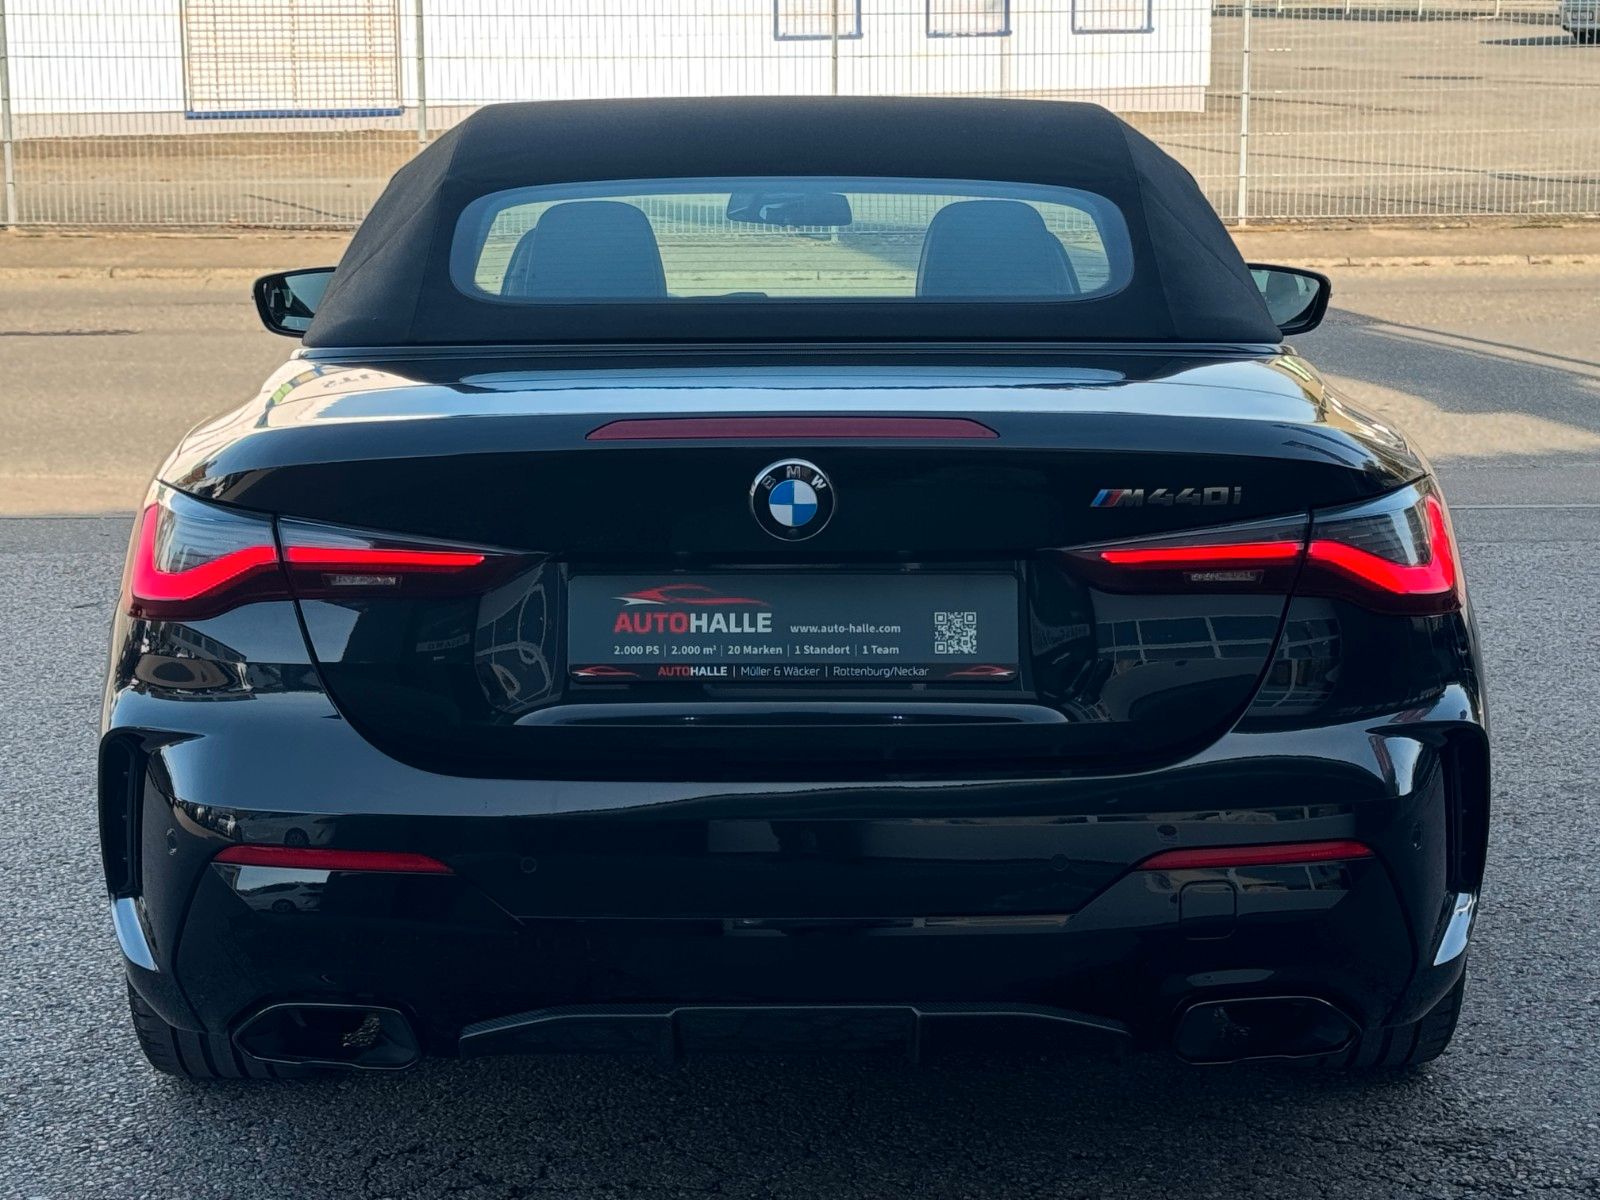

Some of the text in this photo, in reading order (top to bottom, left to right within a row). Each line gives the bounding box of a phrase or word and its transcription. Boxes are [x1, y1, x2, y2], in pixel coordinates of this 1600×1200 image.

[761, 465, 827, 491] BMW
[614, 612, 773, 634] AUTOHALLE
[790, 623, 901, 634] www.auto-halle.com
[613, 645, 644, 655] 2.000
[645, 645, 660, 655] PS
[671, 645, 701, 655] 2.000
[727, 645, 742, 655] 20
[743, 645, 783, 655] Marken
[794, 645, 801, 655] 1
[803, 645, 851, 655] Standort
[862, 645, 869, 655] 1
[871, 645, 900, 655] Team
[658, 665, 930, 679] AUTOHALLE Müller & Wäcker Rottenburg/Neckar
